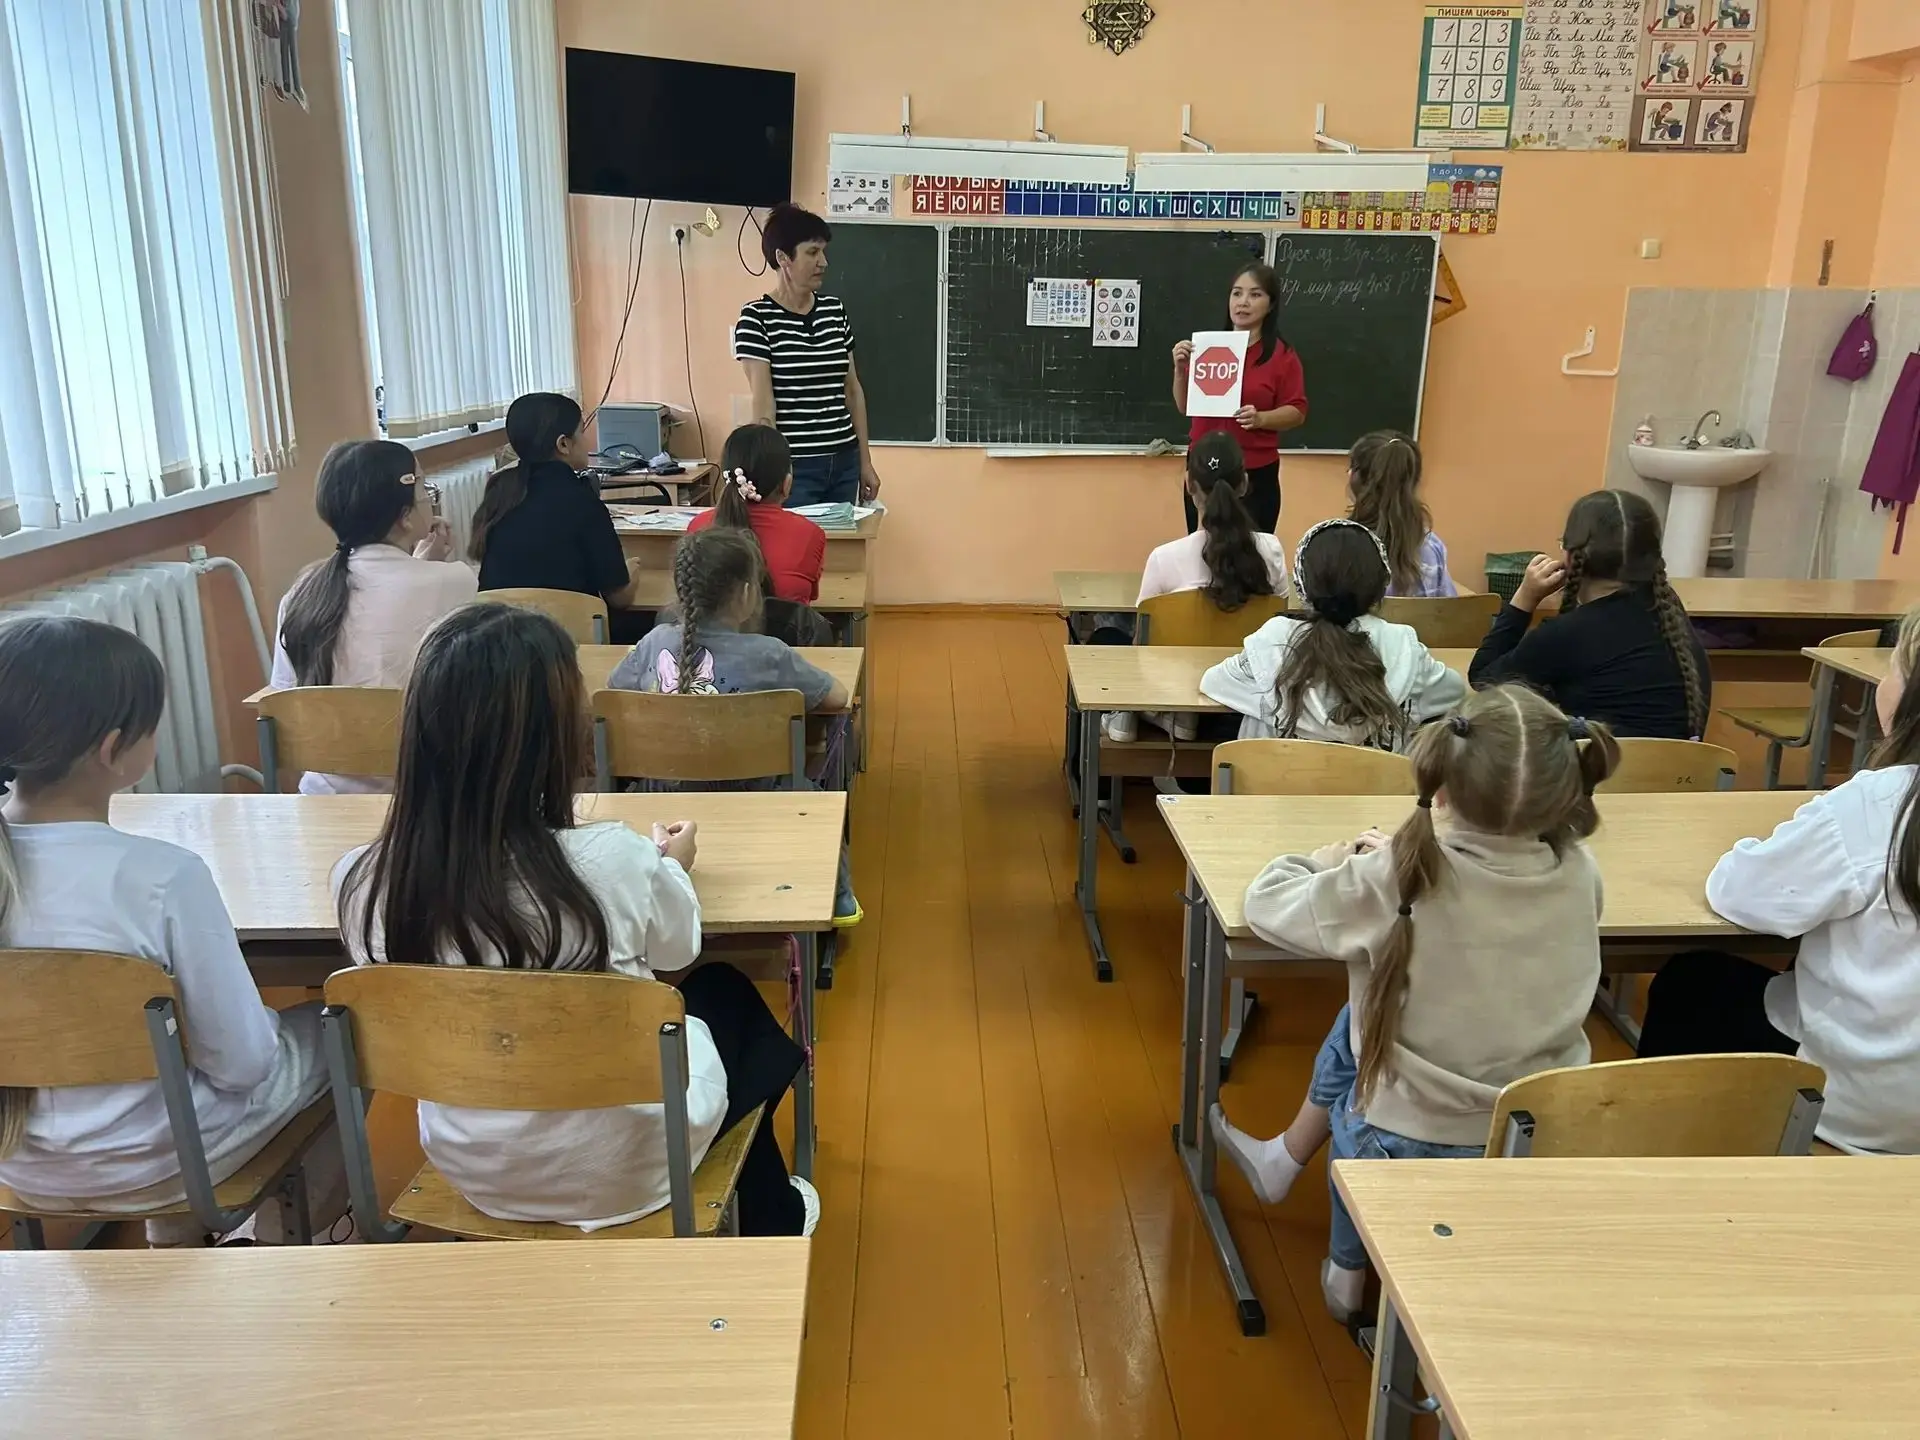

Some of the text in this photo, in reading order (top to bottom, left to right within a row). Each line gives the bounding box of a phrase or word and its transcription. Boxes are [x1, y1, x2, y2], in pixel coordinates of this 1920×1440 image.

[1086, 8, 1094, 22] 9
[1144, 7, 1151, 21] 3
[1438, 9, 1509, 17] ПИШЕМ ЦИФРЫ
[1090, 30, 1096, 43] 8
[1445, 23, 1508, 43] 1 2 3
[1104, 38, 1135, 53] 7 6 5
[1441, 51, 1504, 71] 4 5 6
[1438, 78, 1503, 99] 7 8 9
[1461, 106, 1473, 125] 0
[833, 178, 840, 187] 2
[860, 179, 866, 188] 3
[882, 180, 888, 189] 5
[916, 195, 926, 210] Я
[936, 192, 944, 210] Ё
[952, 196, 966, 210] Ю
[973, 196, 982, 211] И
[991, 196, 999, 211] Е
[1101, 198, 1110, 213] П
[1118, 198, 1128, 213] Ф
[1139, 199, 1147, 213] К
[1157, 199, 1165, 213] Т
[1174, 200, 1186, 214] Ш
[1194, 200, 1203, 214] С
[1211, 201, 1222, 215] Х
[1231, 201, 1240, 218] Ц
[1249, 201, 1257, 215] Ч
[1265, 201, 1279, 219] Щ
[1304, 213, 1309, 223] 0
[1322, 213, 1327, 224] 2
[1340, 214, 1345, 224] 4
[1358, 214, 1363, 225] 6
[1376, 215, 1381, 225] 8
[1393, 215, 1400, 226] 10
[1412, 216, 1420, 227] 12
[1432, 217, 1439, 227] 14
[1452, 217, 1459, 227] 16
[1472, 217, 1478, 228] 18
[1488, 217, 1496, 228] 20
[1195, 362, 1238, 380] STOP
